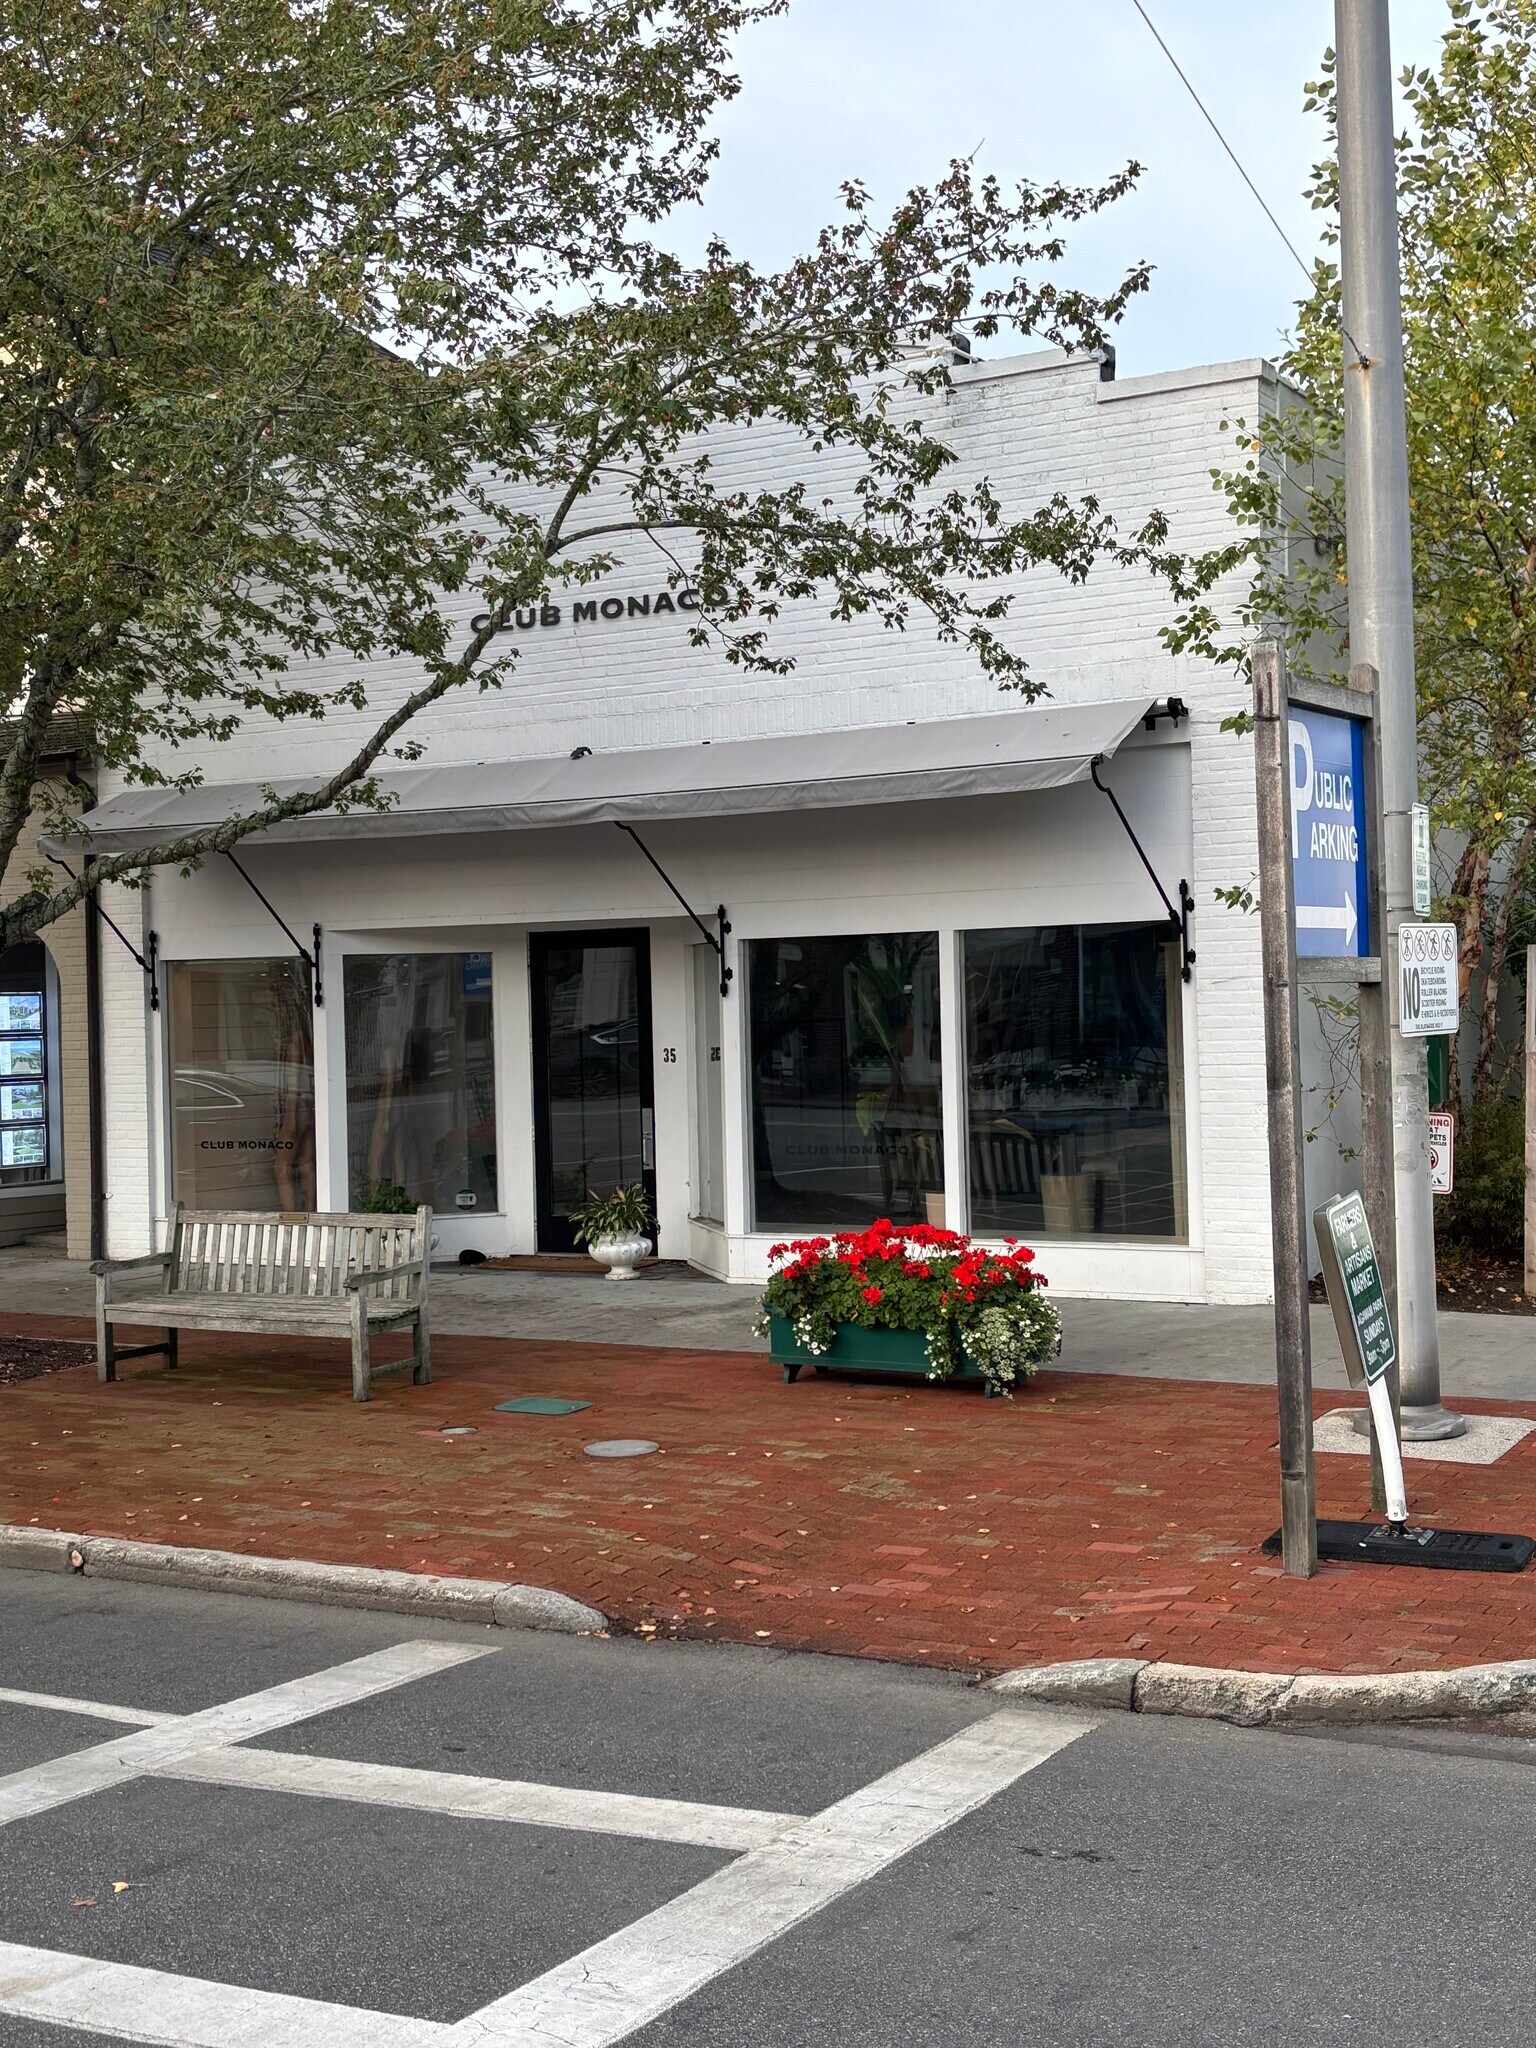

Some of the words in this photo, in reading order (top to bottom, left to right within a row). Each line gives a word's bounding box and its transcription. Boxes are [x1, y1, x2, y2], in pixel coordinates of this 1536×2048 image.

[1421, 977, 1447, 985] SKATEBOARDING
[1403, 967, 1420, 1020] NO
[1421, 988, 1433, 996] ROLLER
[1434, 988, 1447, 996] BLADING
[1421, 999, 1435, 1007] SCOOTER
[663, 1048, 676, 1063] 35
[1429, 1118, 1449, 1127] NING
[200, 1140, 234, 1149] CLUB
[238, 1140, 294, 1150] MONACO
[786, 1145, 830, 1155] CLUB
[835, 1145, 909, 1155] MONACO
[1333, 1205, 1363, 1237] FARMERS
[1350, 1231, 1358, 1250] &
[1344, 1244, 1373, 1276] ARTISANS
[1350, 1265, 1375, 1297] MARKET
[1363, 1316, 1385, 1345] SUNDAYS
